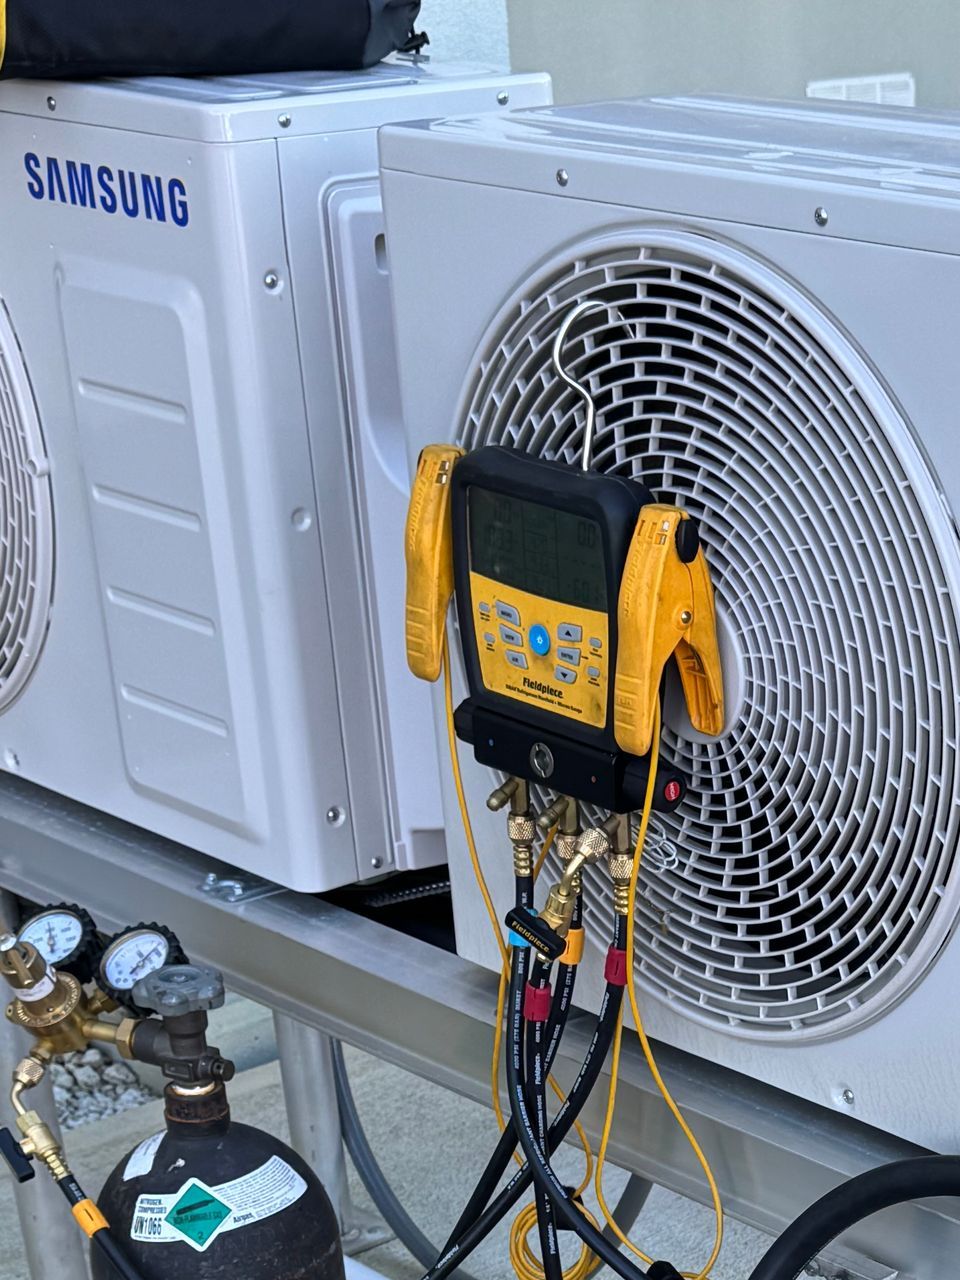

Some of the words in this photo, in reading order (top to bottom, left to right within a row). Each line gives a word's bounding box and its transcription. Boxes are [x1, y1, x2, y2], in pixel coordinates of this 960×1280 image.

[23, 152, 189, 227] SAMSUNG
[523, 677, 563, 698] Fieldpiece
[512, 920, 549, 953] Fieldpiece
[134, 1216, 162, 1235] UN1066
[198, 1232, 204, 1240] 2
